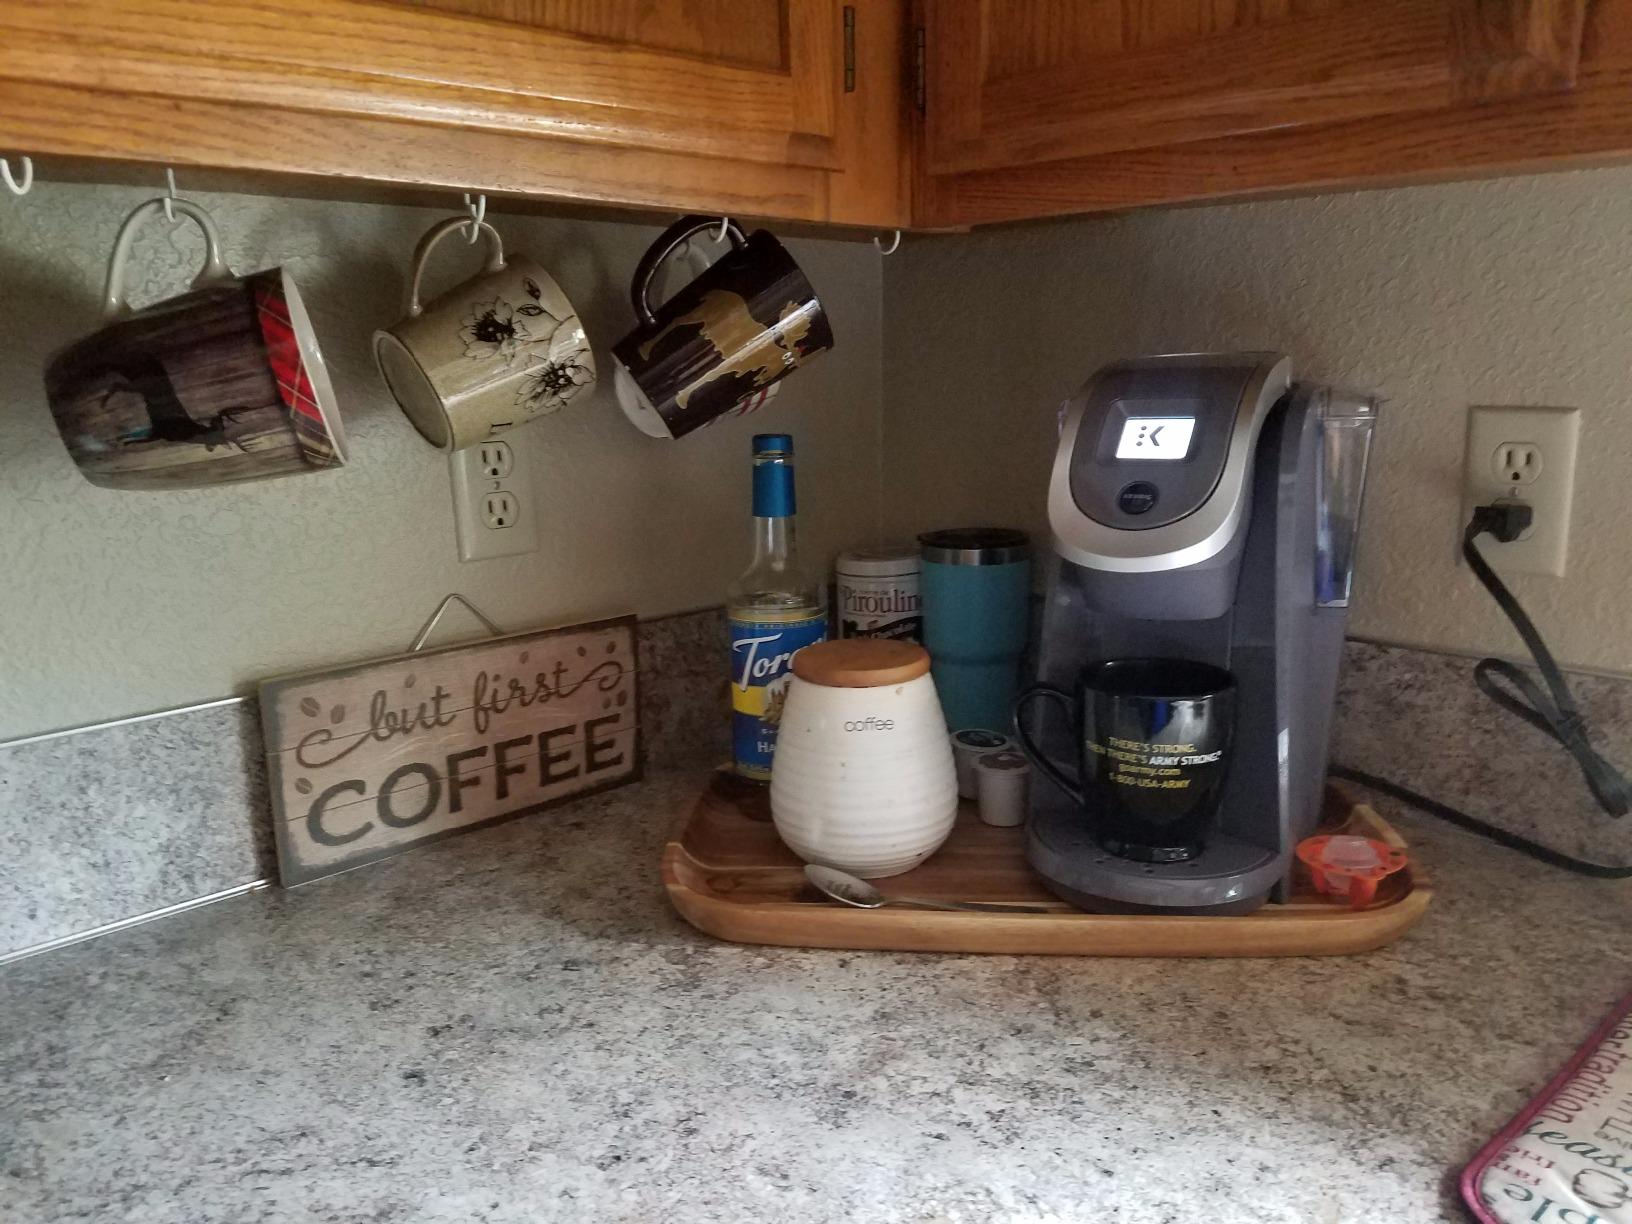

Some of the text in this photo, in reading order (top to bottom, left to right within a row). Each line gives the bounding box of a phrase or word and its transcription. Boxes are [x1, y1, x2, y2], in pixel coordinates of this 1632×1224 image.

[473, 660, 623, 735] first
[844, 716, 895, 733] coffee
[306, 713, 624, 846] COFFEE
[1149, 756, 1180, 766] ARMY
